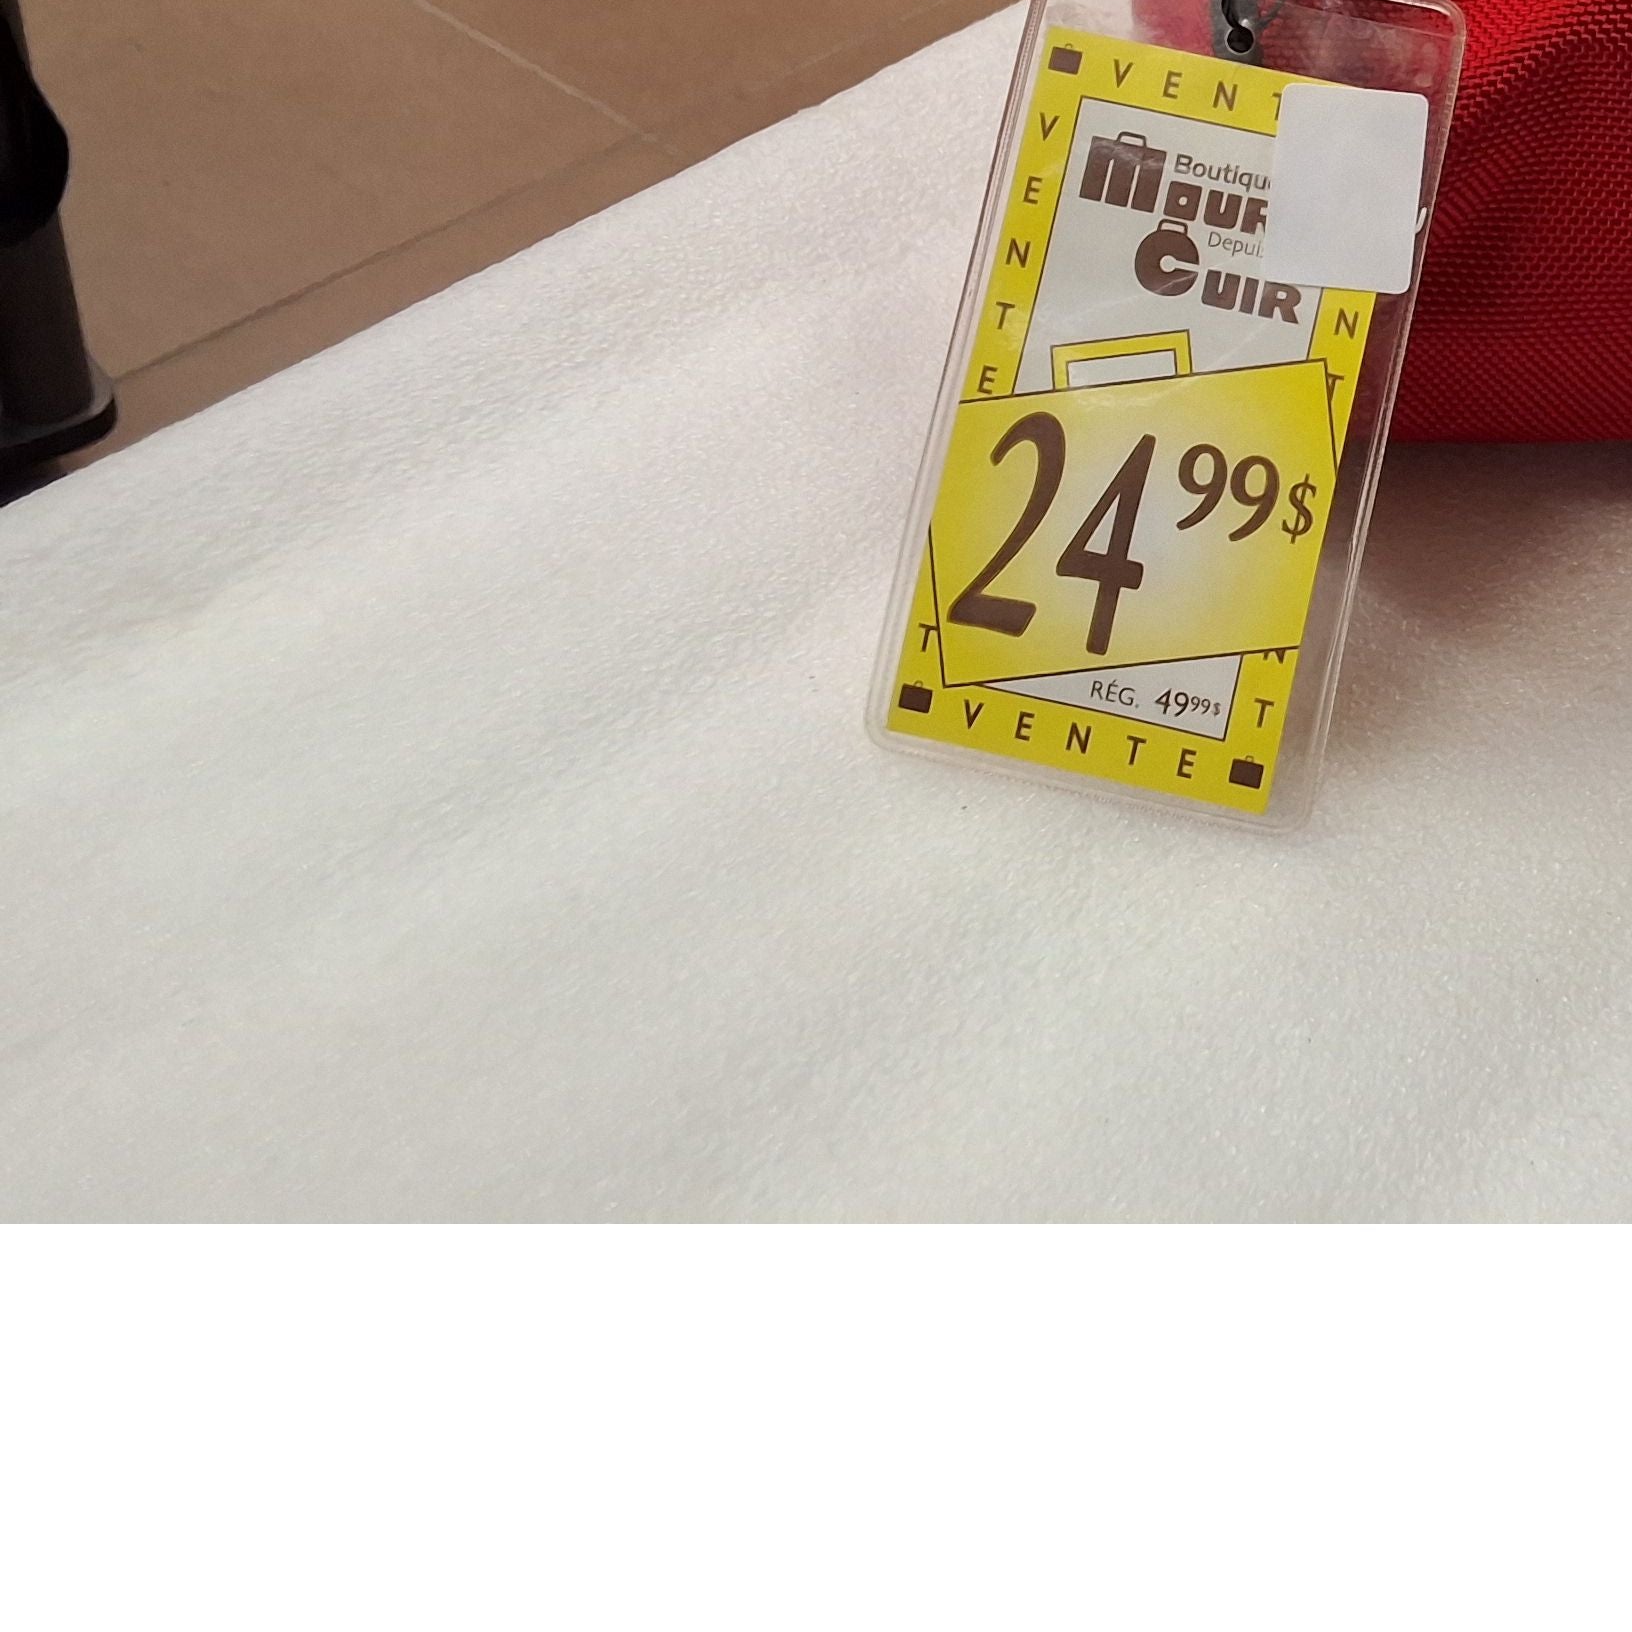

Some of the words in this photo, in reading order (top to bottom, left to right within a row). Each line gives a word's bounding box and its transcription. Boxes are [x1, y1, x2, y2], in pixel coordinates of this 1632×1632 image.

[1173, 153, 1271, 192] Boutiqu
[1207, 230, 1264, 258] Depui
[963, 698, 1198, 780] VENTE
